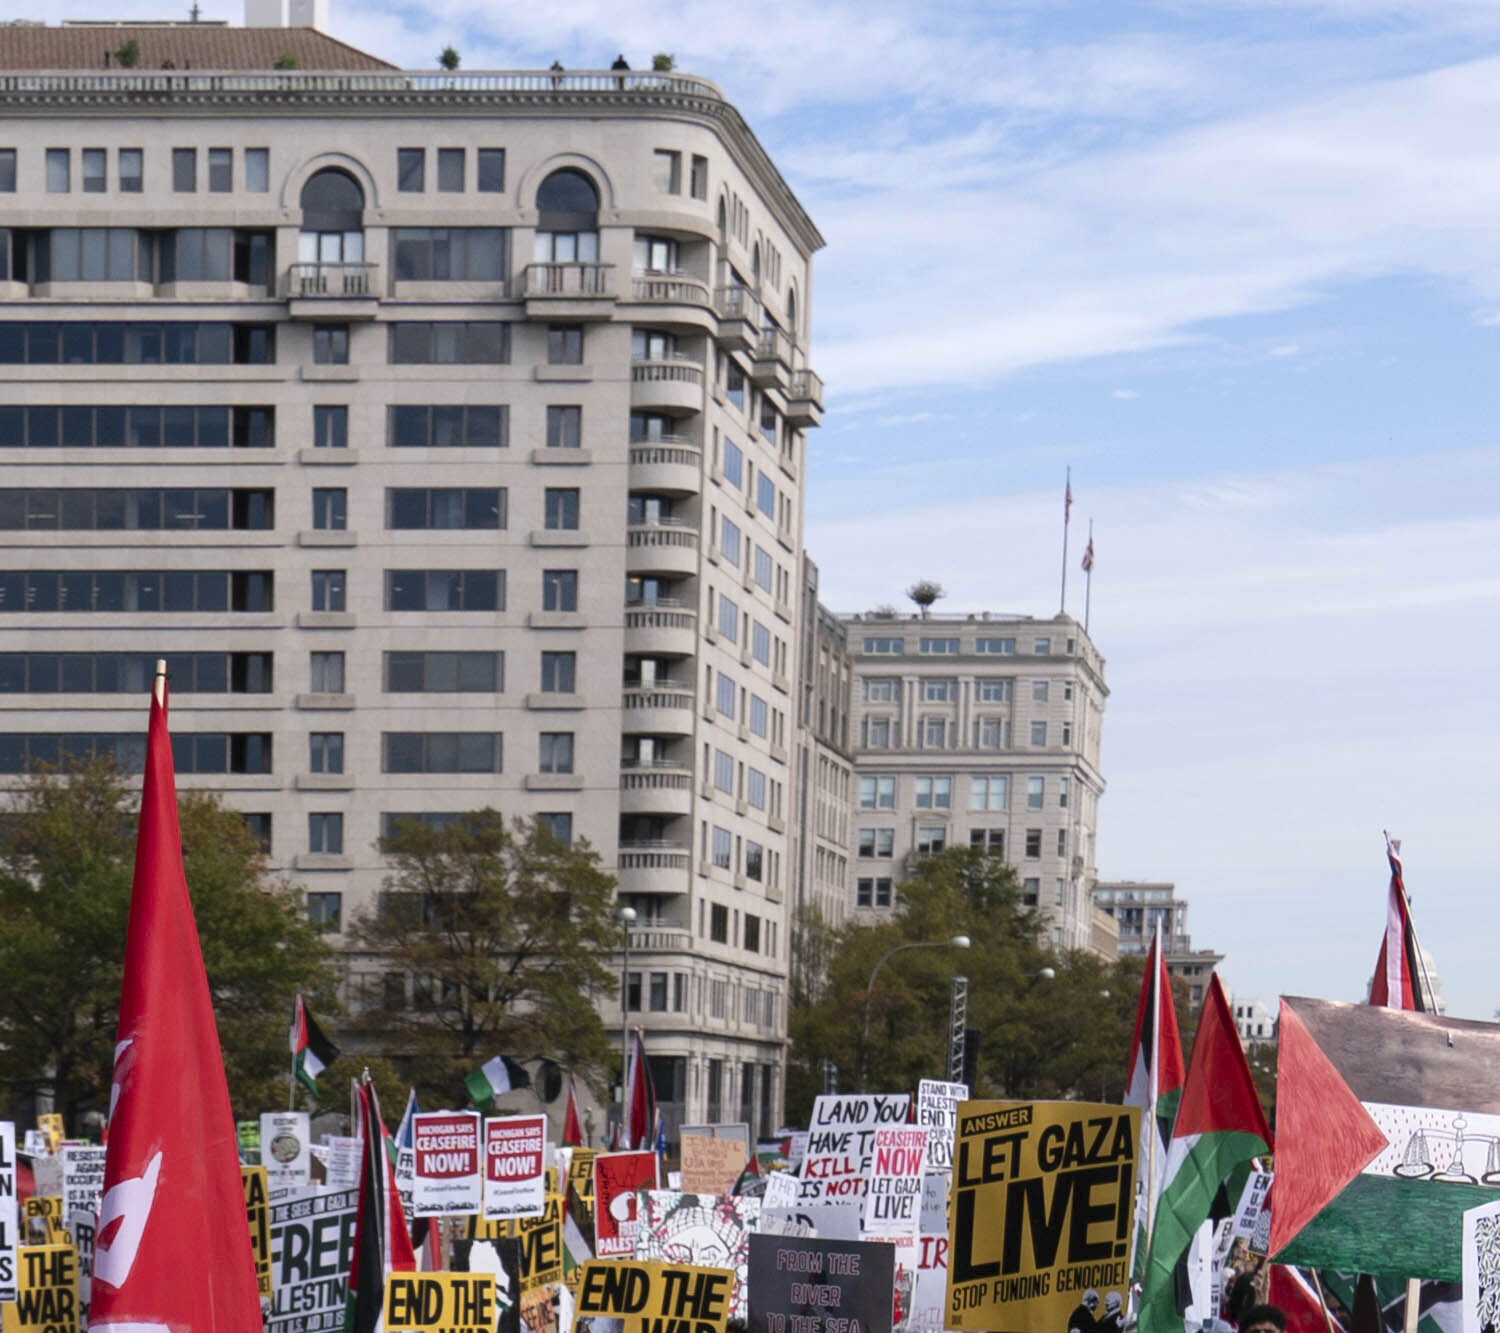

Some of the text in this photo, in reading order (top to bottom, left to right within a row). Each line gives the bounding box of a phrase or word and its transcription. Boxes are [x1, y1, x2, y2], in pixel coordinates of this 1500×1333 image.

[417, 1134, 476, 1150] CEASEFIRE
[424, 1152, 470, 1173] NOW!
[776, 1249, 861, 1276] FROM THE
[791, 1283, 841, 1307] RIVER
